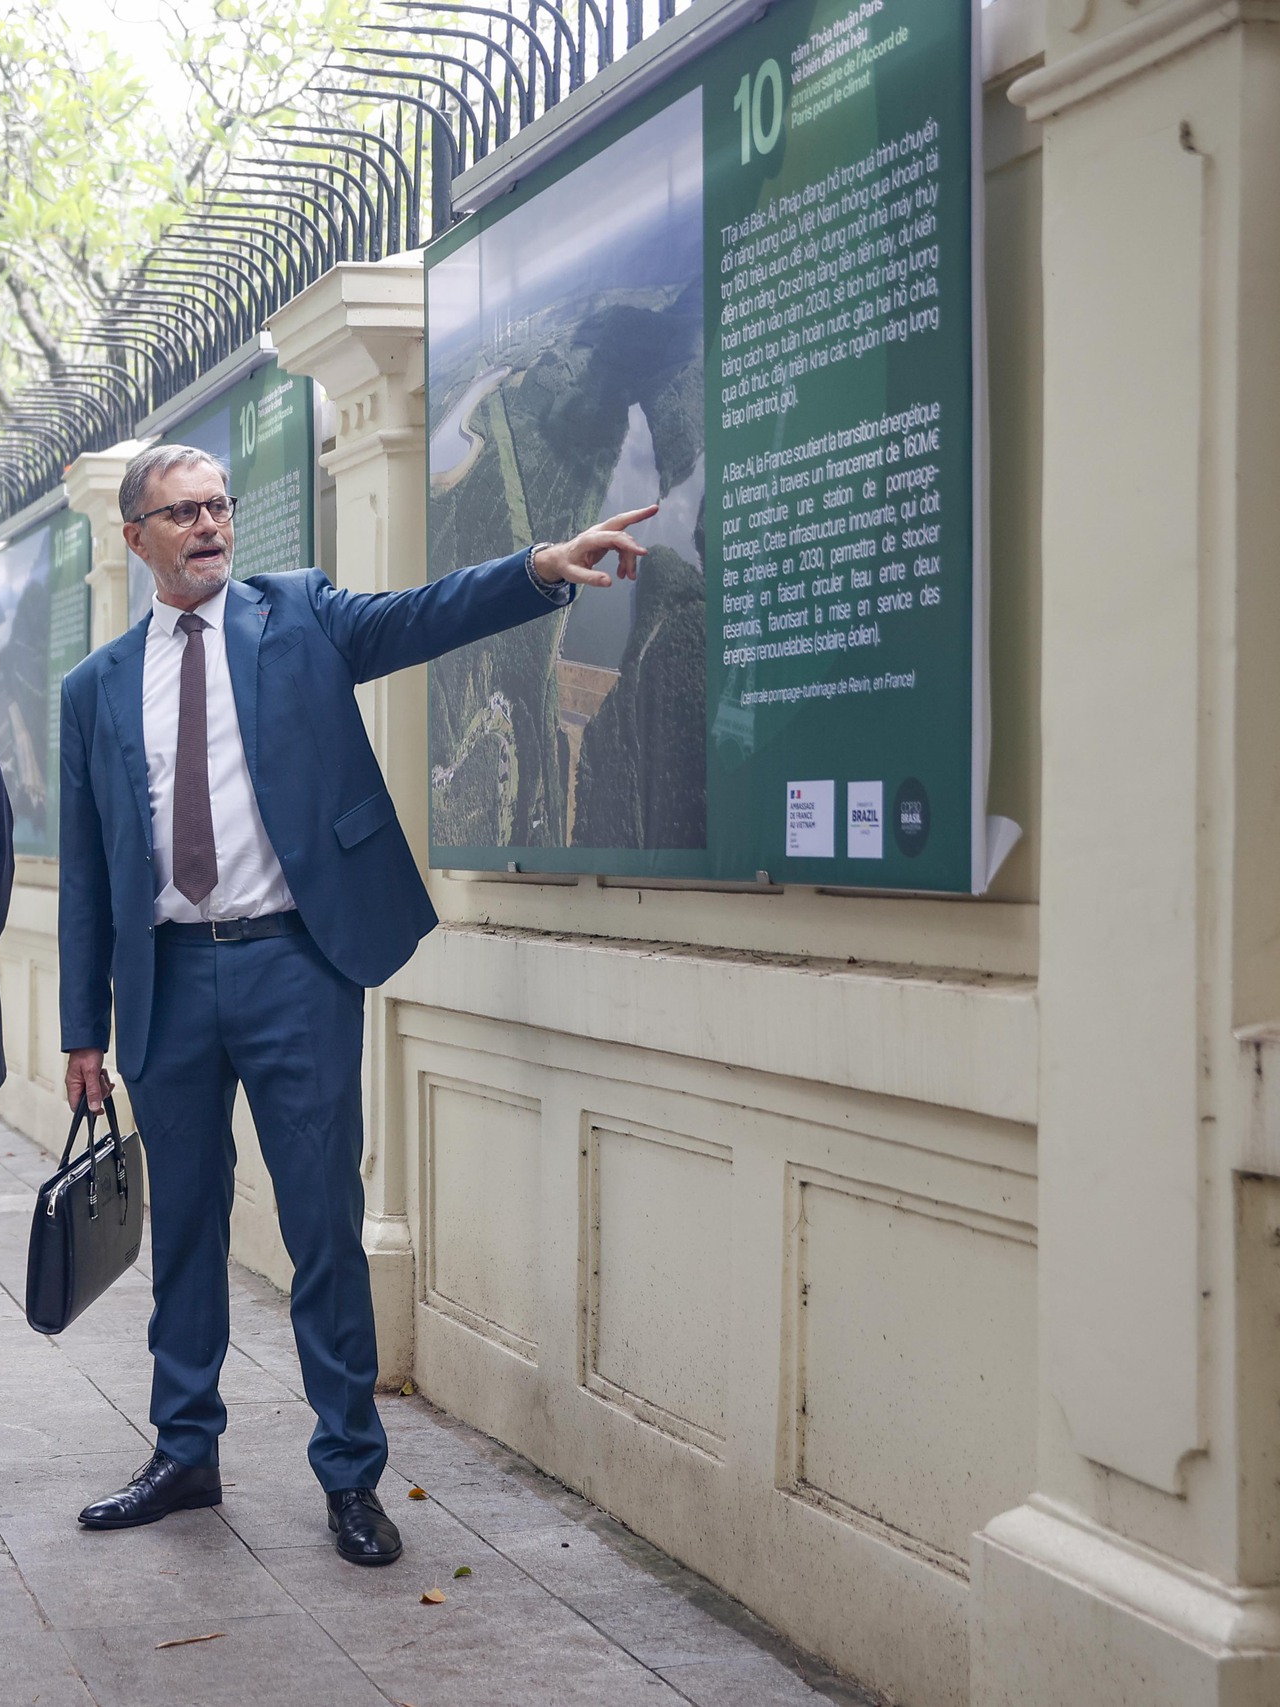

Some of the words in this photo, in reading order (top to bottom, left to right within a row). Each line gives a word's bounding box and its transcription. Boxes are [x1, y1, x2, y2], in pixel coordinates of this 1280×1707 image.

[790, 43, 809, 65] năm
[810, 26, 832, 51] Thỏa
[831, 10, 859, 45] thuận
[859, 0, 883, 21] Paris
[790, 67, 802, 85] về
[802, 54, 821, 78] biến
[835, 30, 851, 58] khí
[850, 26, 867, 49] hậu
[791, 67, 842, 107] anniversaire
[843, 58, 855, 76] de
[856, 31, 894, 68] l'Accord
[894, 26, 908, 45] de
[791, 104, 812, 128] Paris
[812, 93, 833, 120] pour
[843, 69, 870, 98] climat
[733, 58, 783, 166] 10
[734, 244, 754, 266] năng
[780, 219, 796, 244] của
[797, 210, 815, 242] Việt
[816, 202, 839, 226] Nam
[841, 187, 868, 214] thông
[870, 176, 889, 203] qua
[891, 156, 923, 189] khoản
[925, 146, 938, 172] tài
[750, 209, 766, 232] Bác
[778, 190, 801, 221] Pháp
[802, 180, 825, 205] đang
[826, 166, 839, 193] hỗ
[840, 163, 855, 186] trợ
[855, 149, 874, 181] quá
[876, 139, 897, 167] trình
[899, 116, 938, 158] chuyển
[720, 303, 737, 326] điện
[738, 295, 753, 317] tích
[753, 288, 776, 310] năng.
[777, 279, 791, 300] Cơ
[791, 269, 803, 294] sở
[803, 269, 815, 290] hạ
[817, 251, 837, 282] tầng
[838, 249, 855, 273] tiên
[857, 237, 874, 264] tiến
[876, 231, 896, 257] này,
[898, 223, 913, 247] dự
[914, 204, 936, 239] kiến
[733, 270, 748, 293] 160
[749, 262, 767, 286] triệu
[768, 255, 788, 277] euro
[789, 240, 802, 267] để
[803, 237, 820, 262] xây
[821, 227, 846, 253] dựng
[847, 213, 867, 240] một
[869, 202, 888, 230] nhà
[889, 192, 912, 220] máy
[721, 327, 741, 351] hoàn
[742, 317, 765, 342] thành
[766, 308, 782, 331] vào
[783, 302, 803, 324] năm
[805, 287, 831, 316] 2030,
[833, 280, 845, 304] sẽ
[846, 274, 863, 298] tích
[865, 265, 880, 290] trữ
[881, 258, 907, 285] năng
[721, 355, 741, 377] bằng
[743, 345, 763, 368] cách
[764, 341, 779, 362] tạo
[780, 329, 800, 353] tuần
[802, 319, 824, 345] hoàn
[852, 300, 873, 330] giữa
[876, 289, 891, 315] hai
[909, 273, 938, 302] chứa,
[721, 384, 736, 407] qua
[737, 374, 749, 397] đó
[751, 368, 769, 392] thúc
[770, 359, 787, 392] đẩy
[788, 351, 807, 377] triển
[809, 344, 828, 370] khai
[829, 338, 847, 362] các
[848, 326, 879, 358] nguồn
[881, 318, 907, 342] năng
[239, 400, 257, 459] 10
[731, 408, 745, 428] tạo
[745, 397, 764, 423] (mặt
[764, 391, 779, 414] trời,
[780, 384, 798, 413] gió).
[729, 462, 745, 481] Bac
[763, 448, 792, 470] France
[793, 435, 827, 462] soutient
[837, 420, 878, 448] transition
[735, 483, 769, 505] Vietnam,
[779, 471, 809, 493] travers
[811, 466, 823, 484] un
[826, 446, 883, 479] financement
[885, 441, 900, 463] de
[903, 427, 940, 457] 160M€
[722, 517, 741, 540] pour
[748, 502, 788, 528] construire
[796, 497, 814, 516] une
[822, 485, 852, 509] station
[862, 477, 876, 499] de
[886, 465, 939, 497] pompage-
[722, 539, 760, 561] turbinage.
[763, 531, 786, 551] Cette
[788, 518, 845, 545] infrastructure
[848, 504, 897, 531] innovante,
[900, 494, 916, 523] qui
[919, 489, 940, 514] doit
[722, 568, 738, 587] être
[743, 557, 777, 583] achevée
[799, 546, 824, 571] 2030,
[830, 539, 876, 568] permettra
[881, 531, 895, 553] de
[901, 523, 940, 549] stocker
[722, 590, 754, 614] l'énergie
[759, 590, 771, 606] en
[777, 580, 805, 602] faisant
[811, 572, 843, 596] circuler
[850, 568, 871, 588] l'eau
[879, 562, 905, 583] entre
[913, 555, 940, 576] deux
[722, 615, 761, 639] réservoirs,
[768, 608, 808, 631] favorisant
[828, 599, 851, 621] mise
[857, 598, 870, 616] en
[877, 588, 912, 613] service
[919, 584, 940, 606] des
[723, 643, 755, 667] énergies
[756, 635, 813, 659] renouvelables
[813, 629, 846, 654] (solaire,
[847, 622, 880, 647] éolien).
[740, 688, 768, 706] (centrale
[884, 669, 915, 688] France)
[852, 810, 878, 822] BRAZIL
[901, 814, 921, 824] BRASIL
